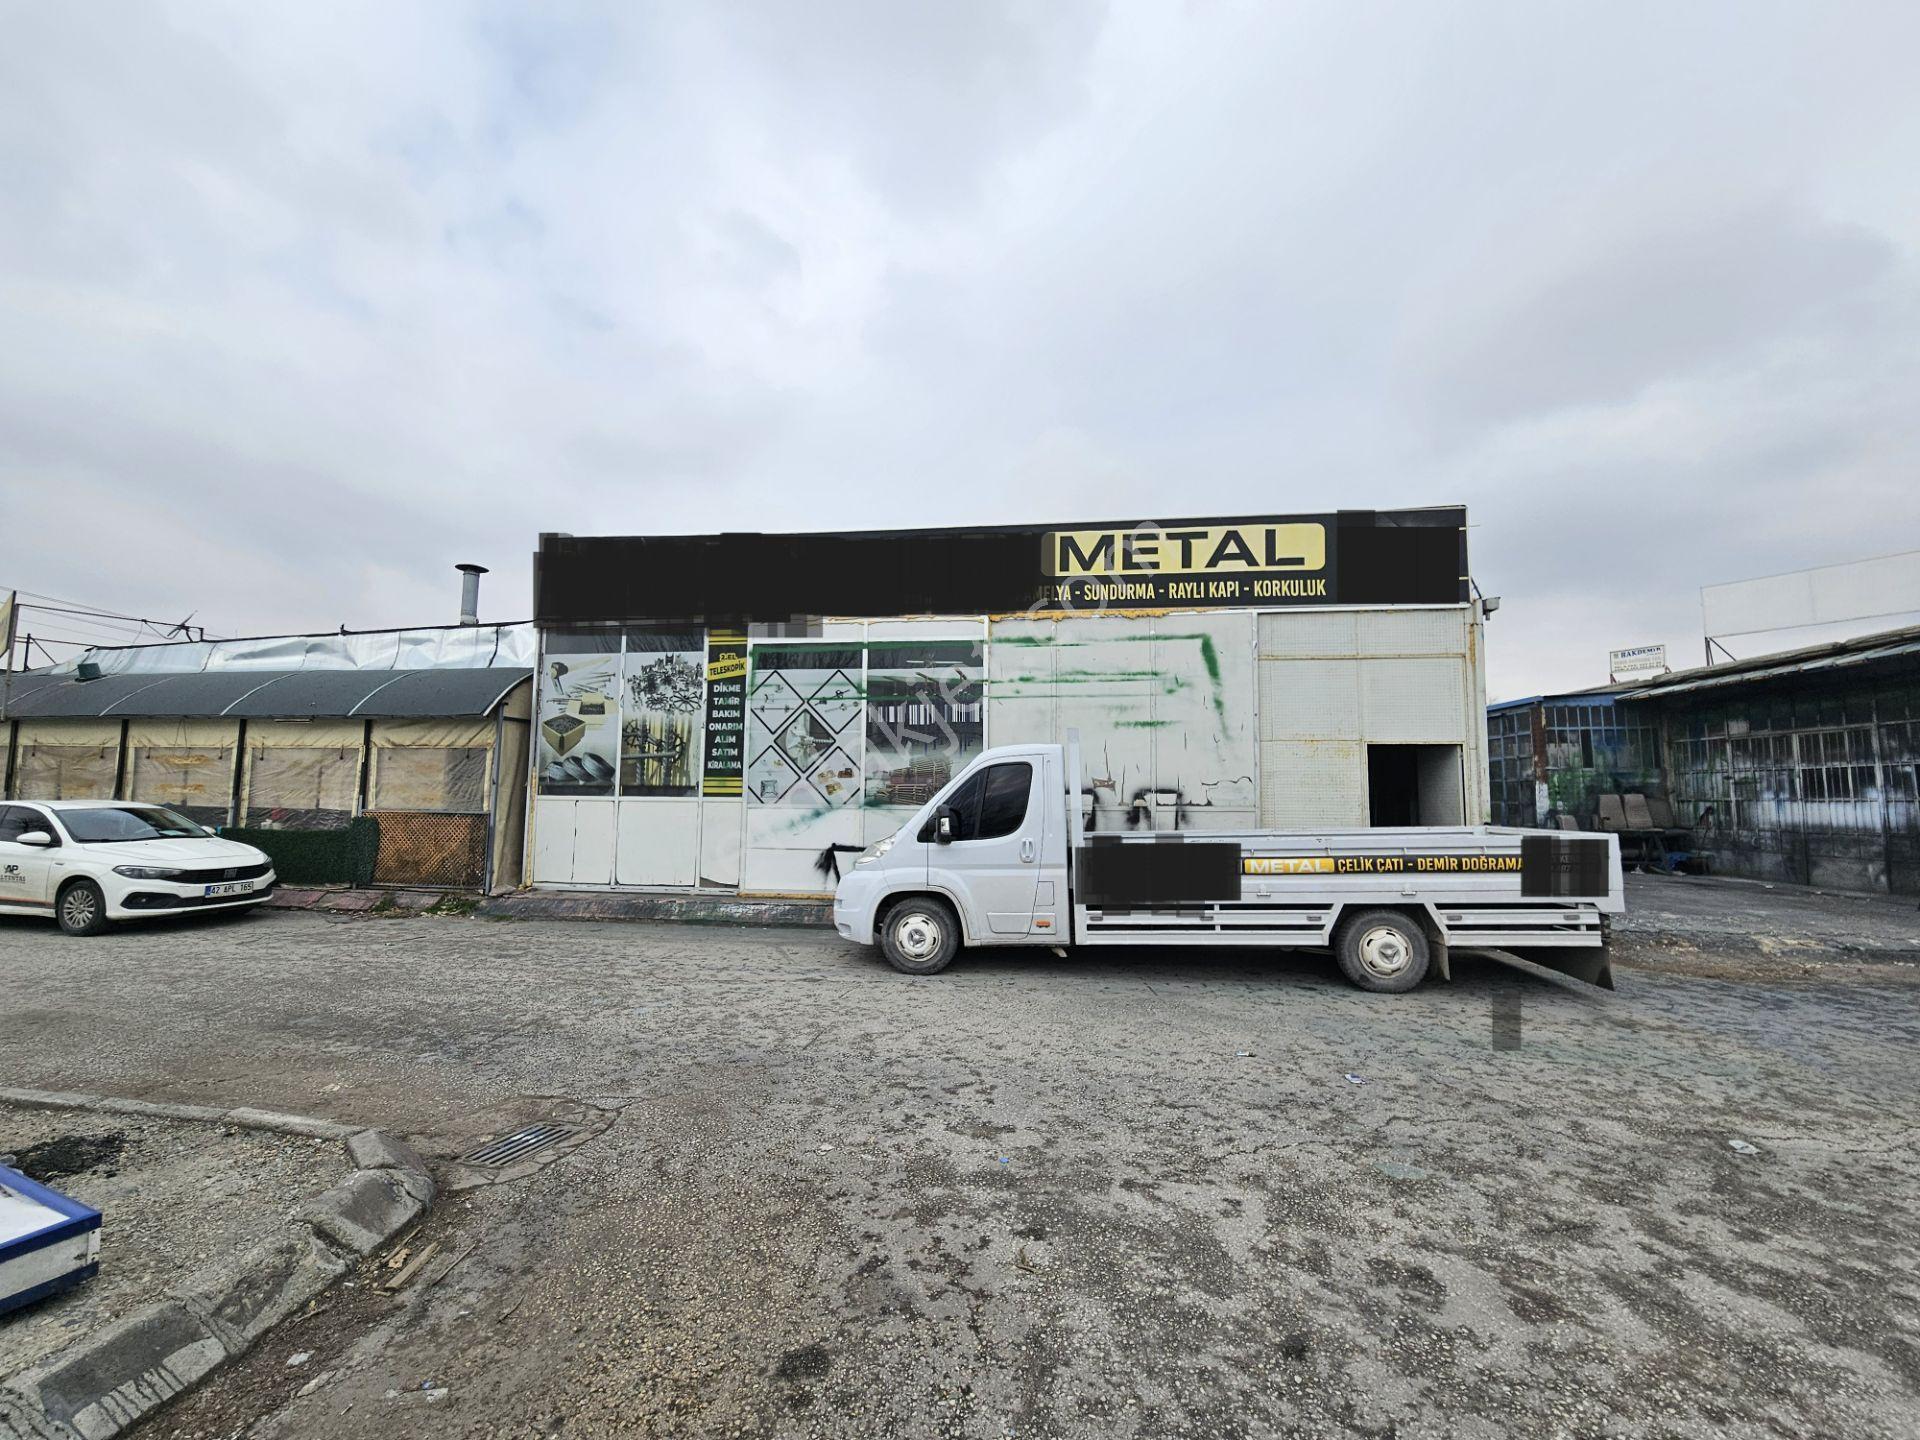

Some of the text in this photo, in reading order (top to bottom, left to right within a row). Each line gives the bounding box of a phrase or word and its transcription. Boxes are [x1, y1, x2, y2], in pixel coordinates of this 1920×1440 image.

[1059, 528, 1305, 573] METAL
[1084, 582, 1156, 602] SUNDURMA
[1168, 582, 1205, 599] RAYLI
[1209, 580, 1240, 598] KAPI
[1254, 578, 1327, 597] KORKULUK
[709, 660, 745, 676] TELESKOPİK
[713, 682, 741, 693] DİKME
[713, 696, 740, 706] TAMİR
[712, 709, 741, 718] BAKIM
[708, 722, 744, 731] ONARIM
[714, 735, 737, 744] ALIM
[711, 748, 738, 757] SATIM
[707, 760, 742, 769] KİRALAMA
[1249, 858, 1330, 874] METAL
[1337, 856, 1374, 874] ÇELİK
[1376, 858, 1404, 874] ÇATI
[1417, 855, 1459, 871] DEMİR
